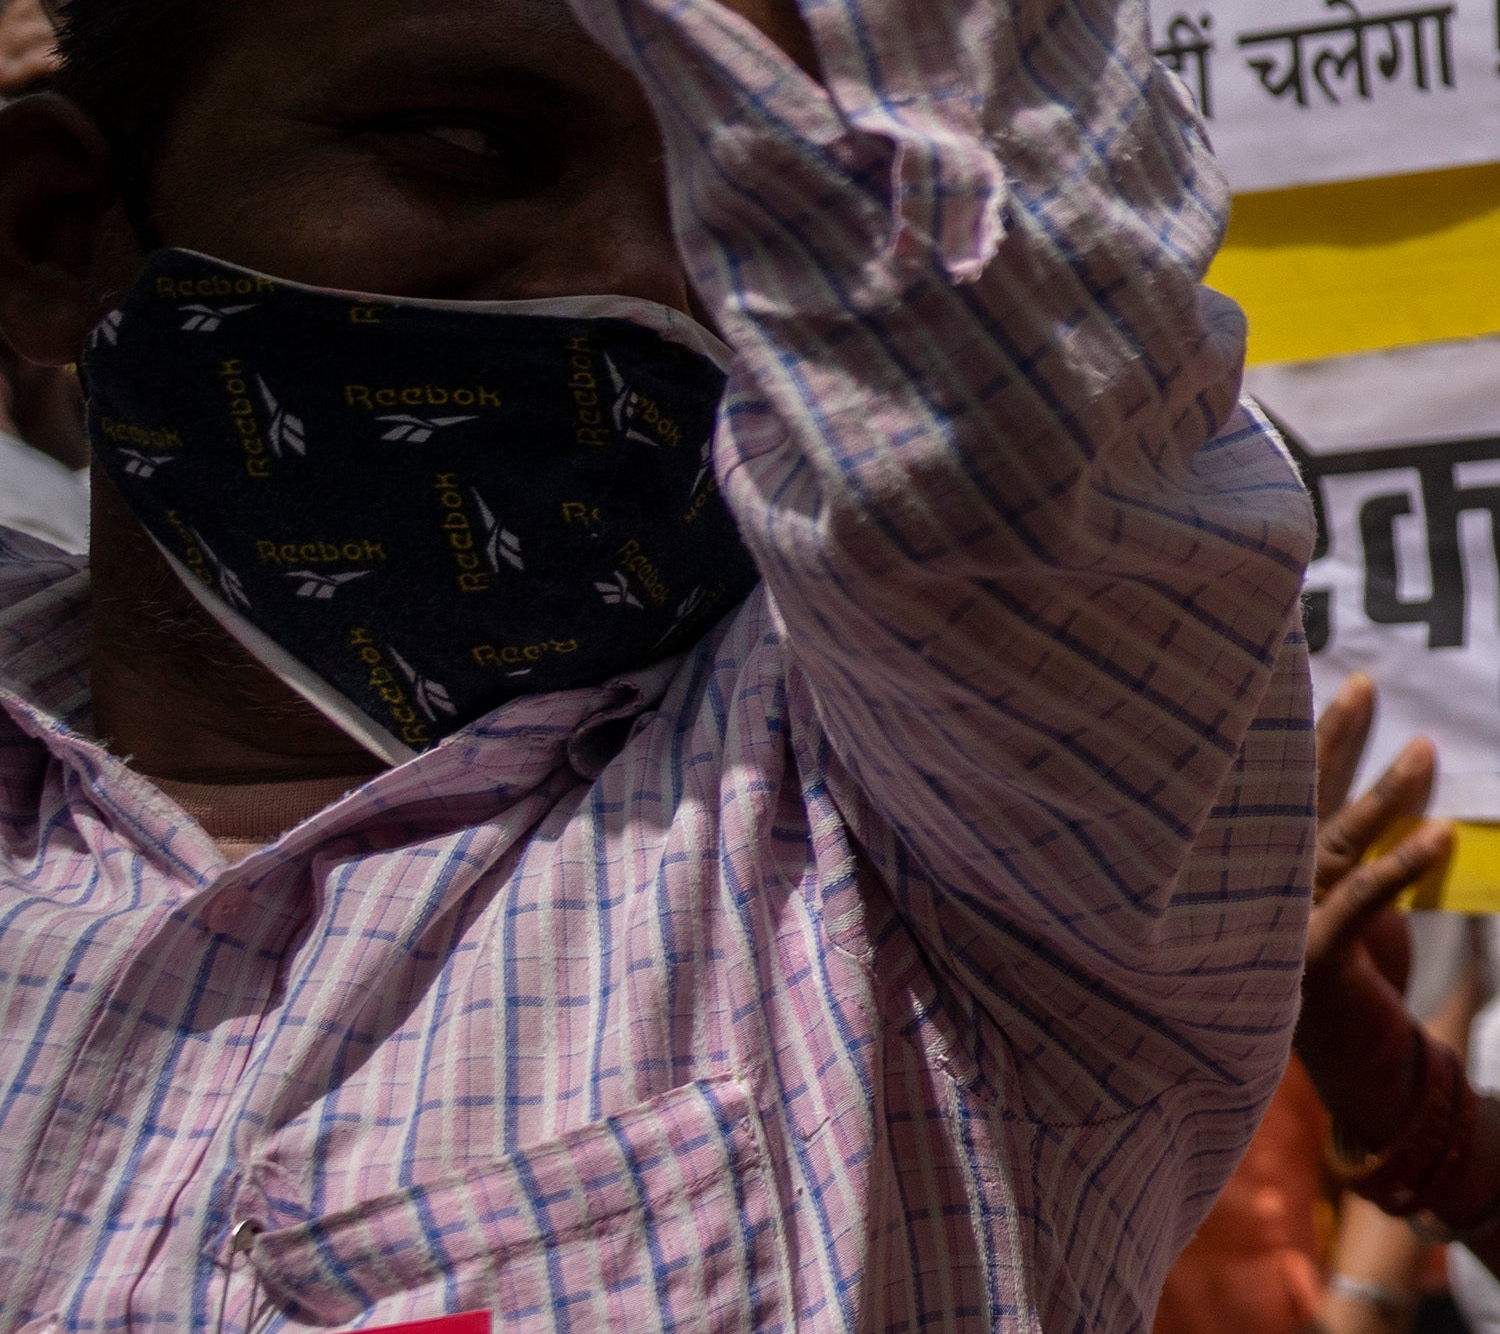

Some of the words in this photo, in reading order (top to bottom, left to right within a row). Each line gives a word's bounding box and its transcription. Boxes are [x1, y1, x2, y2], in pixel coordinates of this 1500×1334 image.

[343, 381, 501, 411] Reebok
[430, 470, 490, 594] Reebok
[256, 540, 388, 567] Reebok
